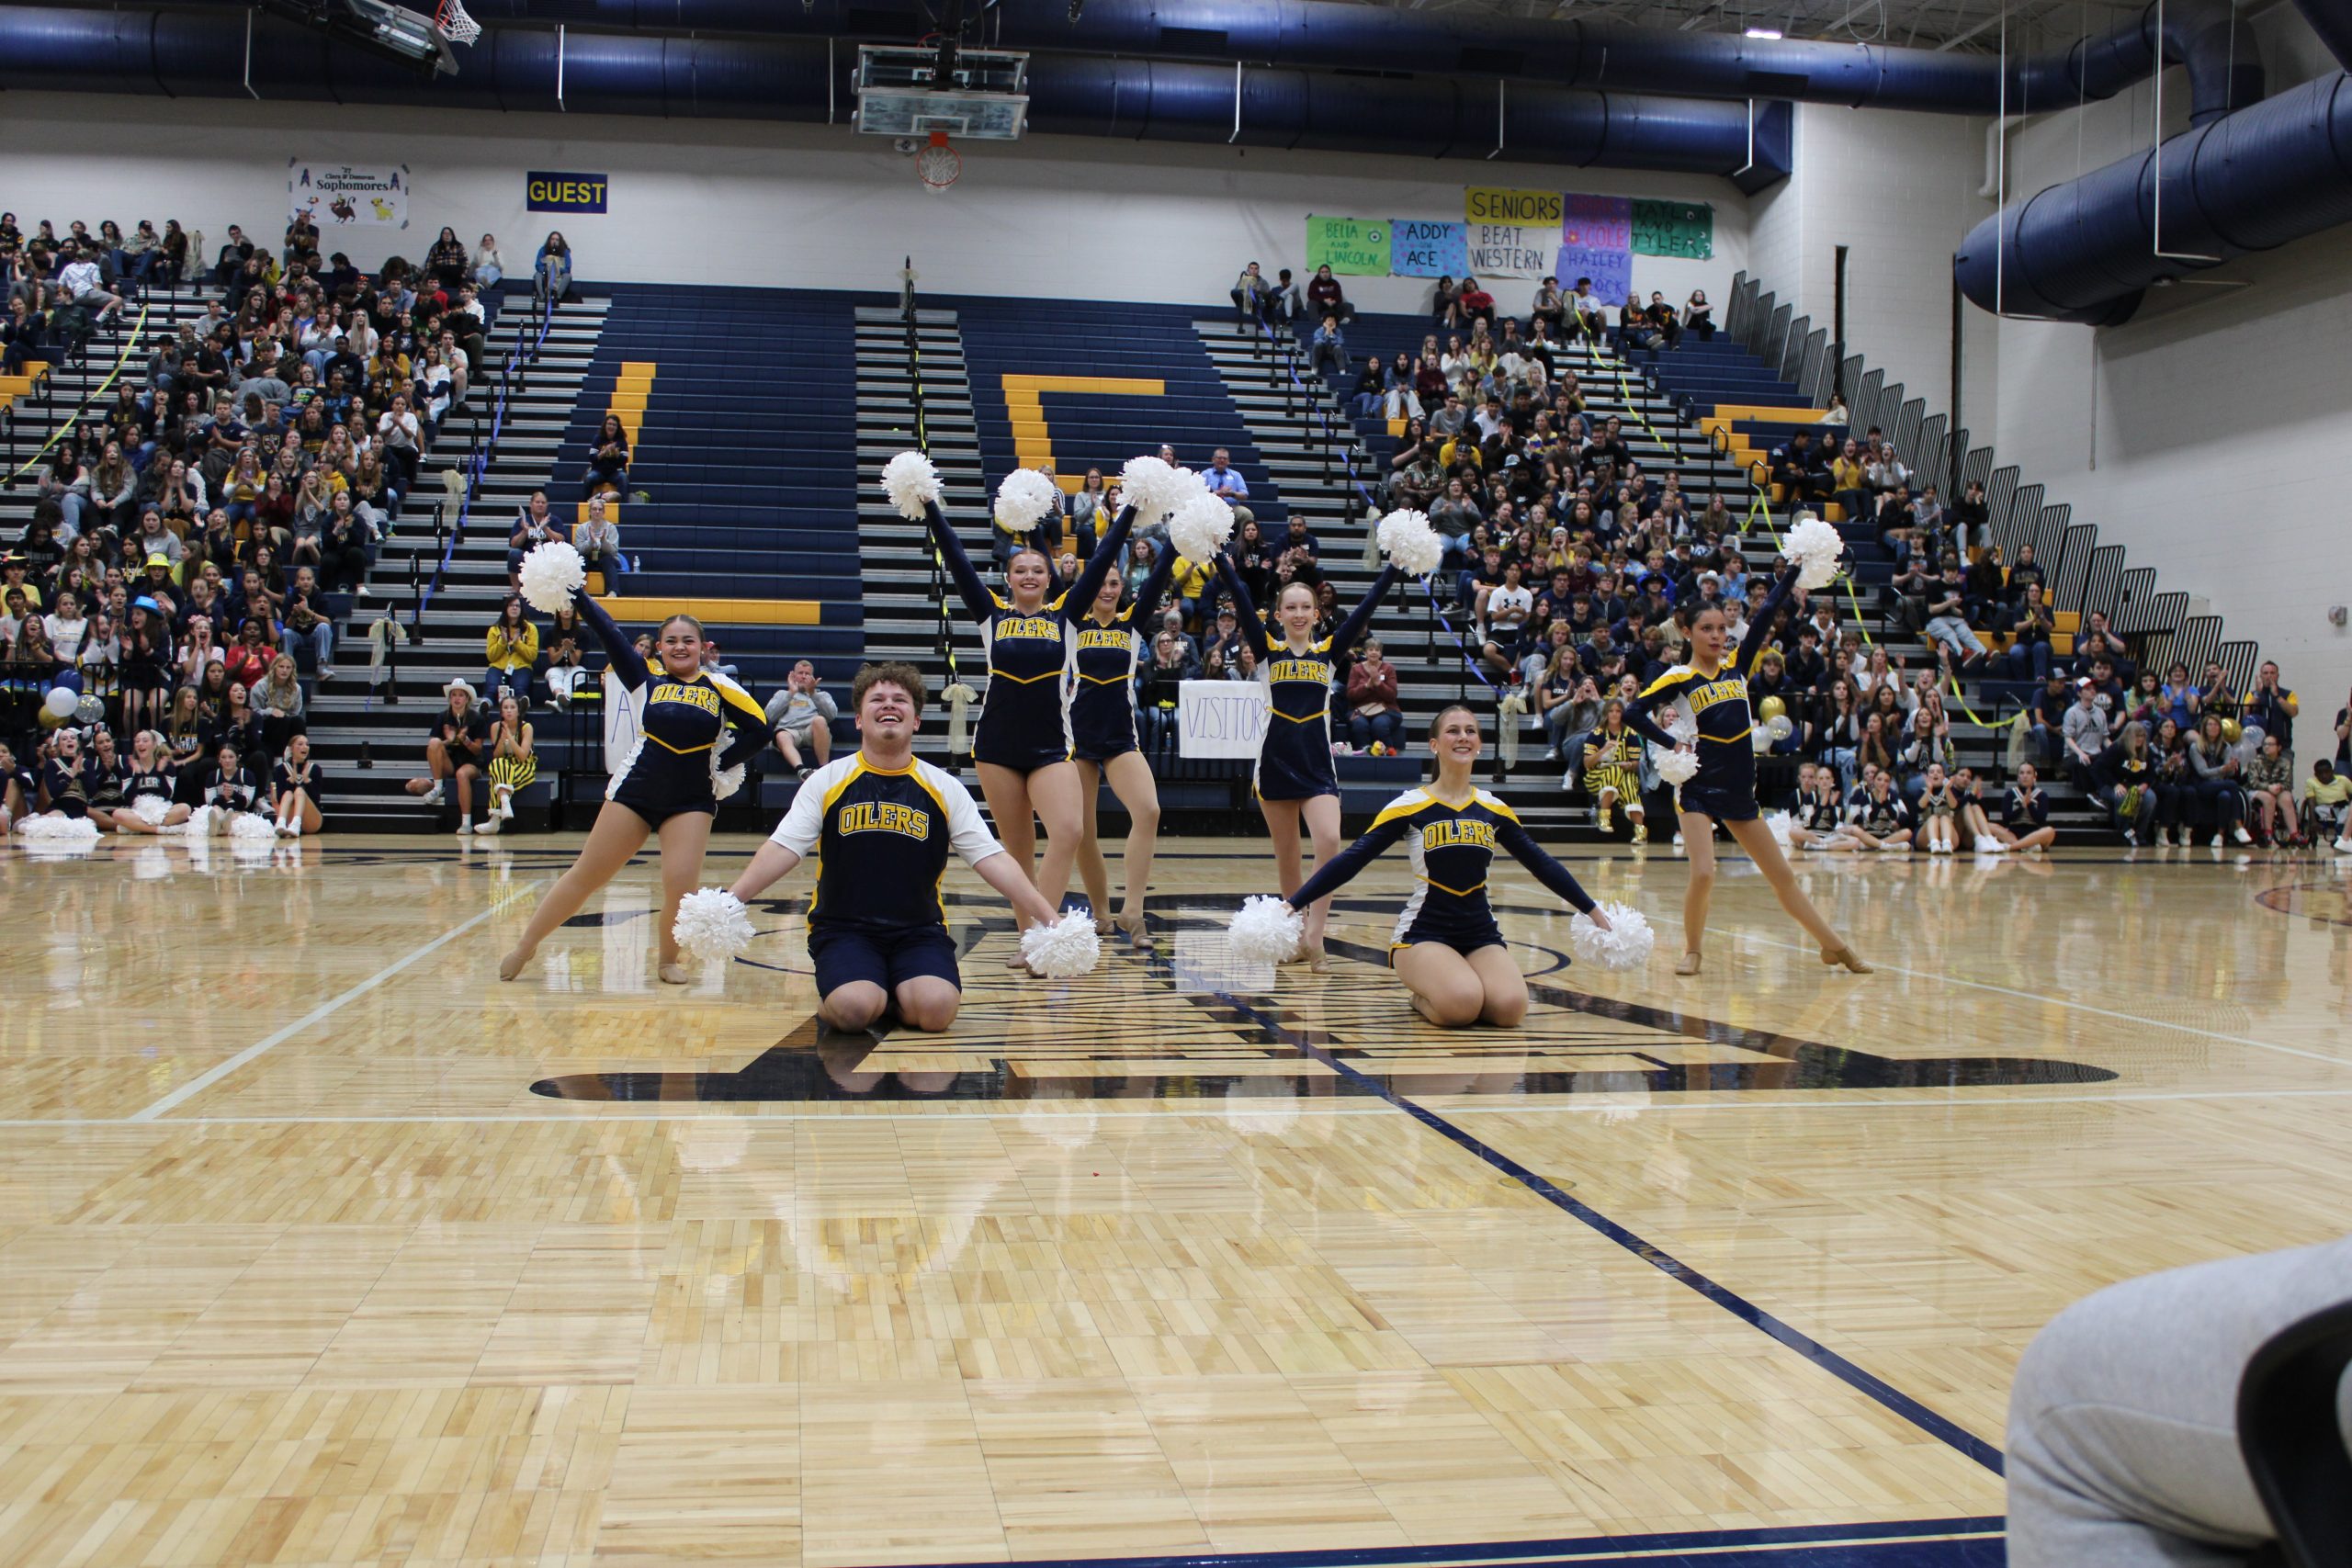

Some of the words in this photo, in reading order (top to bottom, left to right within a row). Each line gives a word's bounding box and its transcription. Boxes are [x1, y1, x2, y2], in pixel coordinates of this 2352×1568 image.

[316, 180, 389, 192] Sophomores
[529, 181, 605, 204] GUEST
[1472, 191, 1561, 220] SENIORS
[1326, 222, 1358, 239] BELLA
[1406, 223, 1451, 241] ADDY
[1482, 225, 1523, 245] BEAT
[1585, 227, 1625, 248] COLE
[1325, 251, 1378, 265] LINCOLN
[1406, 250, 1439, 266] ACE
[1471, 248, 1544, 270] WESTERN
[1567, 252, 1624, 269] HAILEY
[995, 616, 1061, 642] OILERS
[1077, 629, 1131, 651] OILERS
[1270, 659, 1329, 687] OILERS
[650, 683, 720, 717] OILERS
[1688, 680, 1748, 716] OILERS
[839, 802, 929, 840] OILERS
[1422, 819, 1495, 852] OILERS
